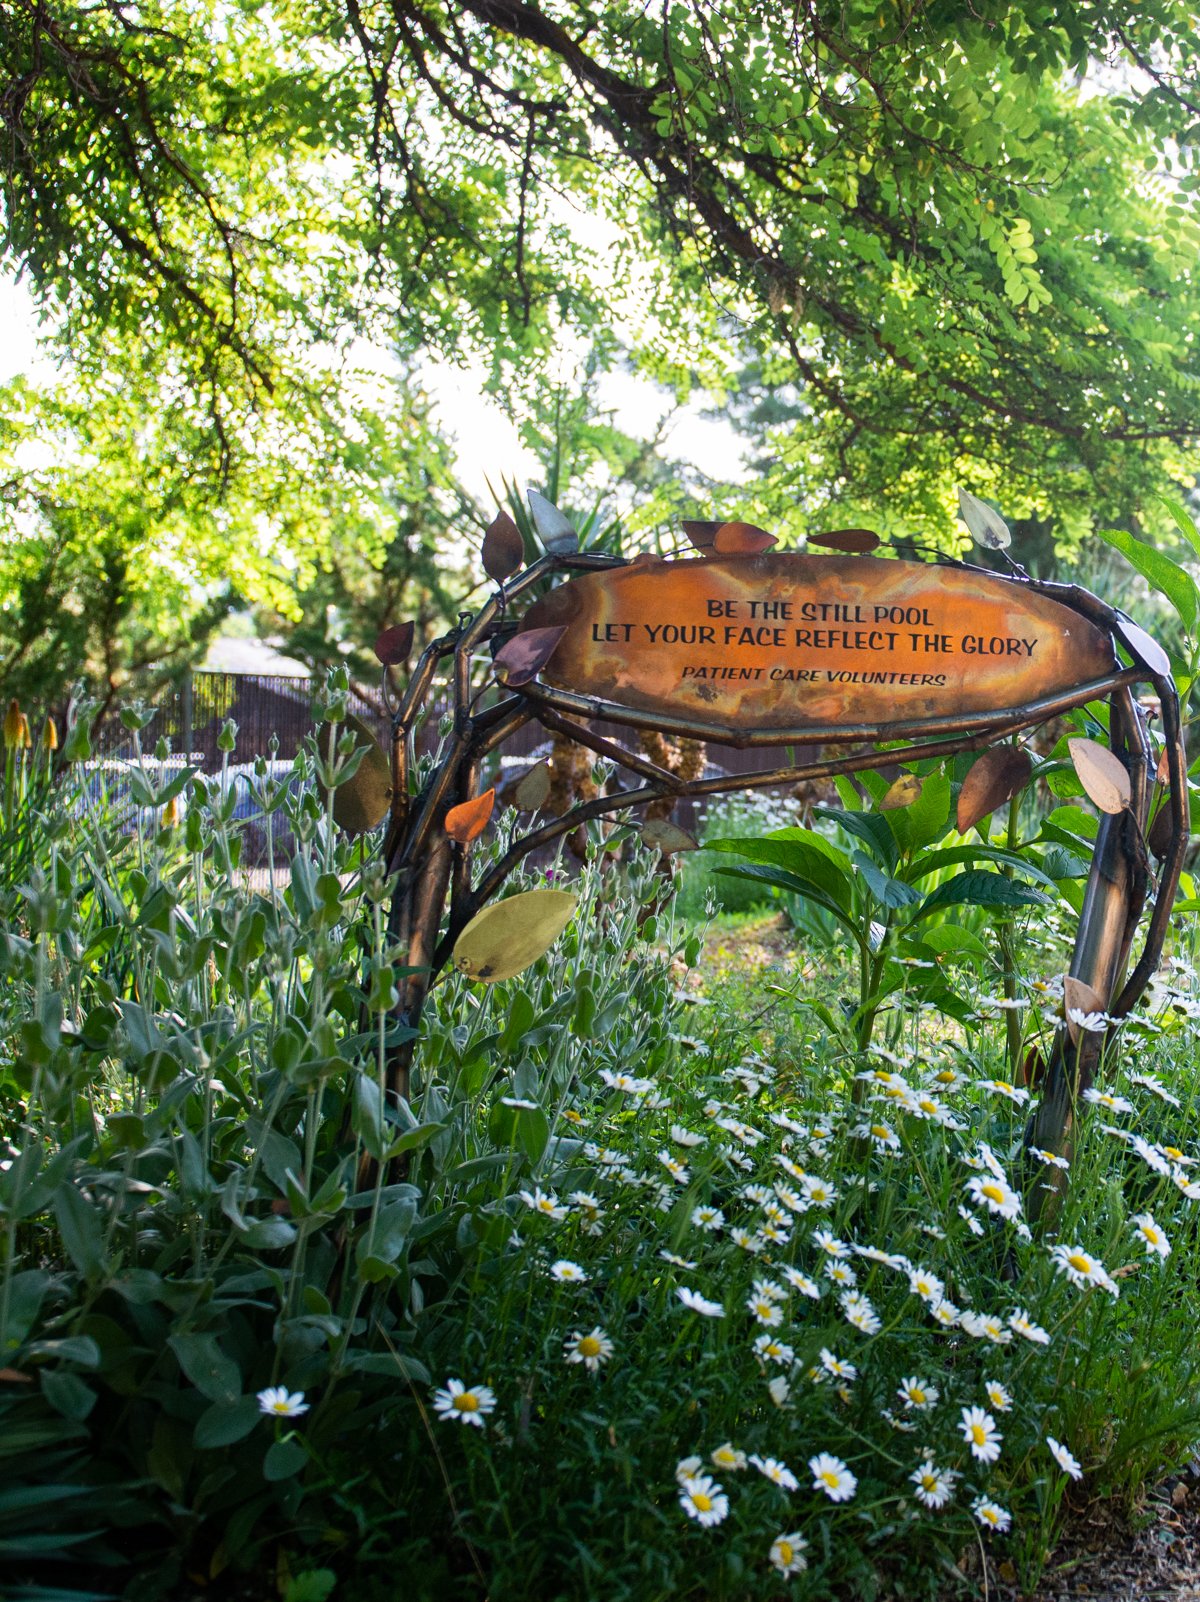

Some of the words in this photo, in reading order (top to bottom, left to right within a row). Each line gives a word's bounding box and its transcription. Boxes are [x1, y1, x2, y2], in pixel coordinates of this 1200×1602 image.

[706, 599, 738, 619] BE
[747, 600, 792, 621] THE
[800, 602, 866, 624] STILL
[873, 606, 934, 626] POOL
[592, 623, 636, 643] LET
[643, 624, 716, 644] YOUR
[724, 626, 786, 647] FACE
[795, 629, 899, 651] REFLECT
[908, 633, 953, 653] THE
[961, 634, 1039, 657] GLORY
[681, 666, 764, 680] PATIENT
[769, 668, 821, 686] CARE
[826, 670, 947, 687] VOLUNTEERS
